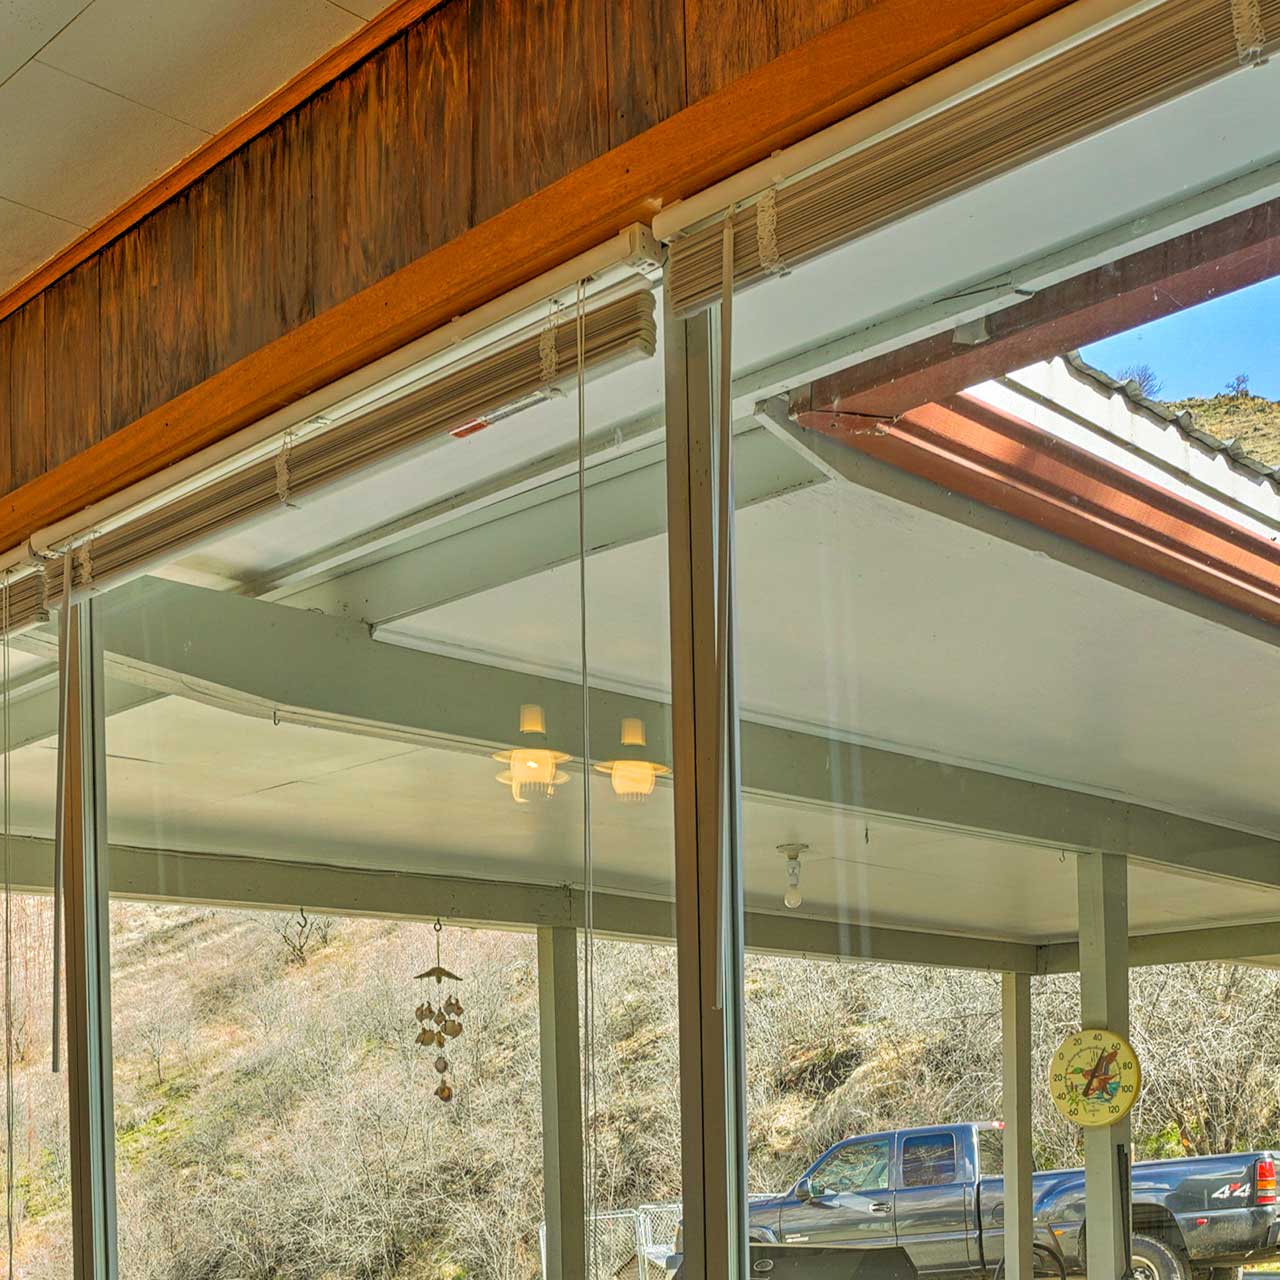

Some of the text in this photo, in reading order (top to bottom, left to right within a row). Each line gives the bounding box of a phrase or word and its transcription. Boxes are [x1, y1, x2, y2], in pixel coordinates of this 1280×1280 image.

[1092, 1033, 1103, 1041] 40
[1073, 1038, 1082, 1046] 20
[1111, 1042, 1121, 1051] 60
[1059, 1052, 1065, 1061] 0
[1122, 1061, 1133, 1070] 80
[1121, 1085, 1134, 1093] 100
[1108, 1105, 1120, 1114] 120
